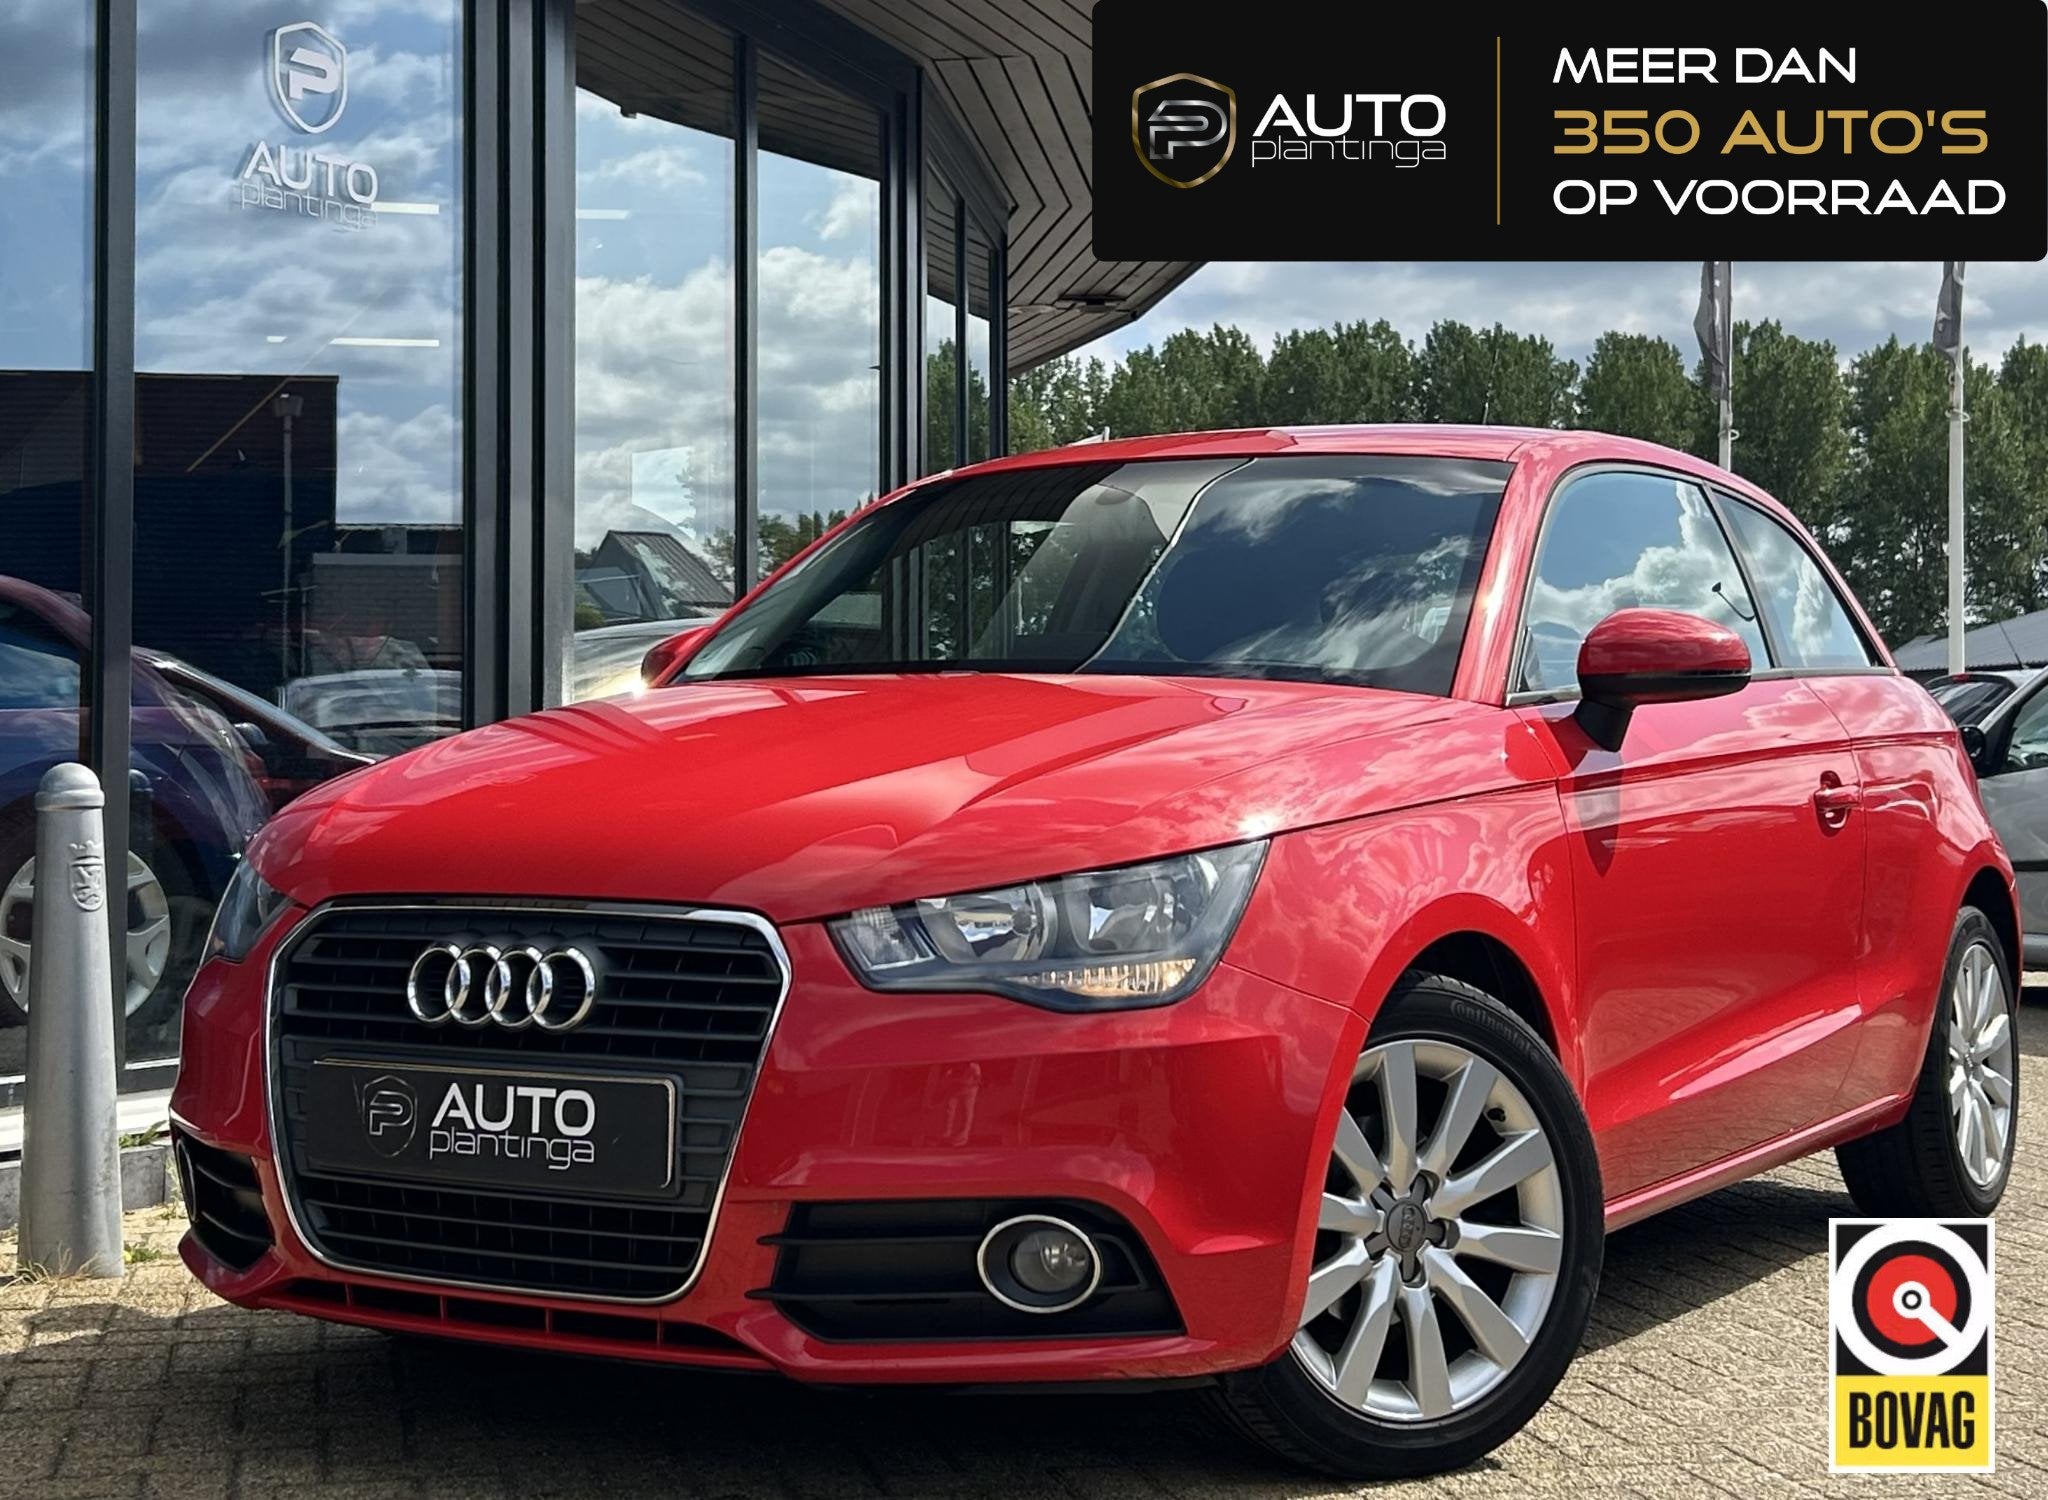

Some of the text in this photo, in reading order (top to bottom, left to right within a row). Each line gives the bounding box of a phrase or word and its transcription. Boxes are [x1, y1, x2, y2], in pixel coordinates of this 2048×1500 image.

[243, 140, 379, 204] AUTO
[241, 182, 378, 232] plantinga
[431, 1082, 596, 1137] AUTO
[429, 1126, 596, 1170] plantinga
